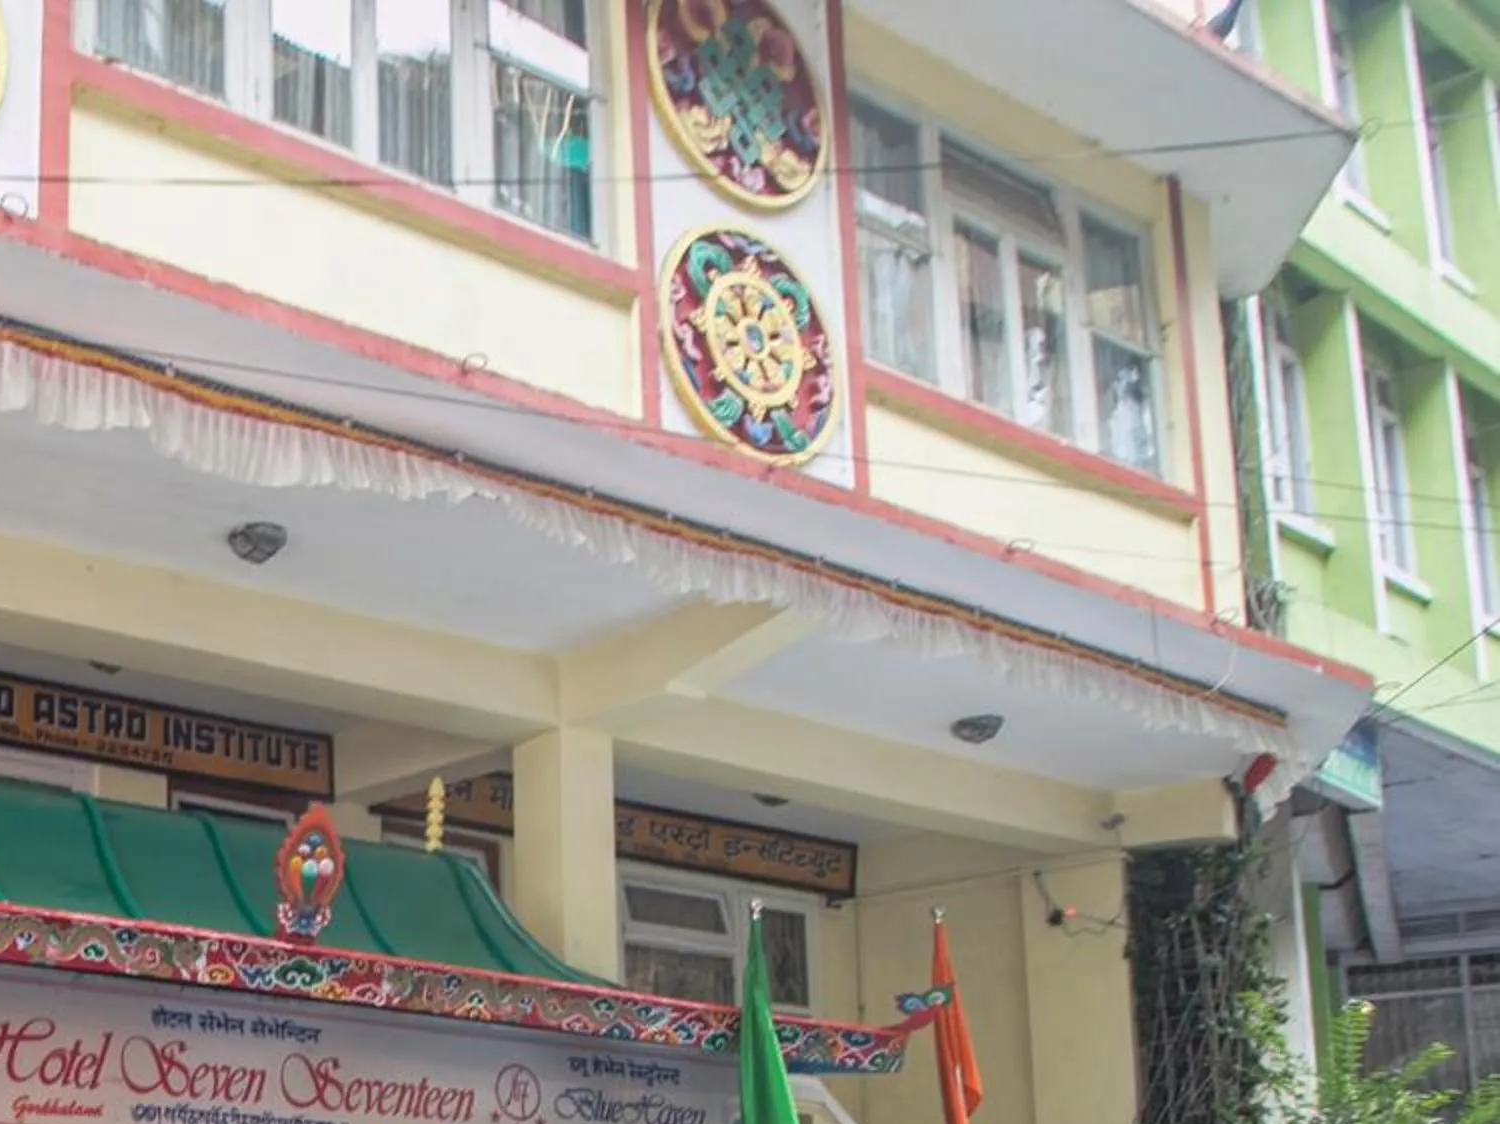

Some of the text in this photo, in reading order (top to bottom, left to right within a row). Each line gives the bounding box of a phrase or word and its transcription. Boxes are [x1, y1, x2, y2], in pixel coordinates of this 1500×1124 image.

[33, 691, 148, 742] ASTRO
[163, 715, 320, 773] INSTITUTE
[120, 1036, 266, 1107] Seven
[280, 1052, 476, 1123] Seventeen
